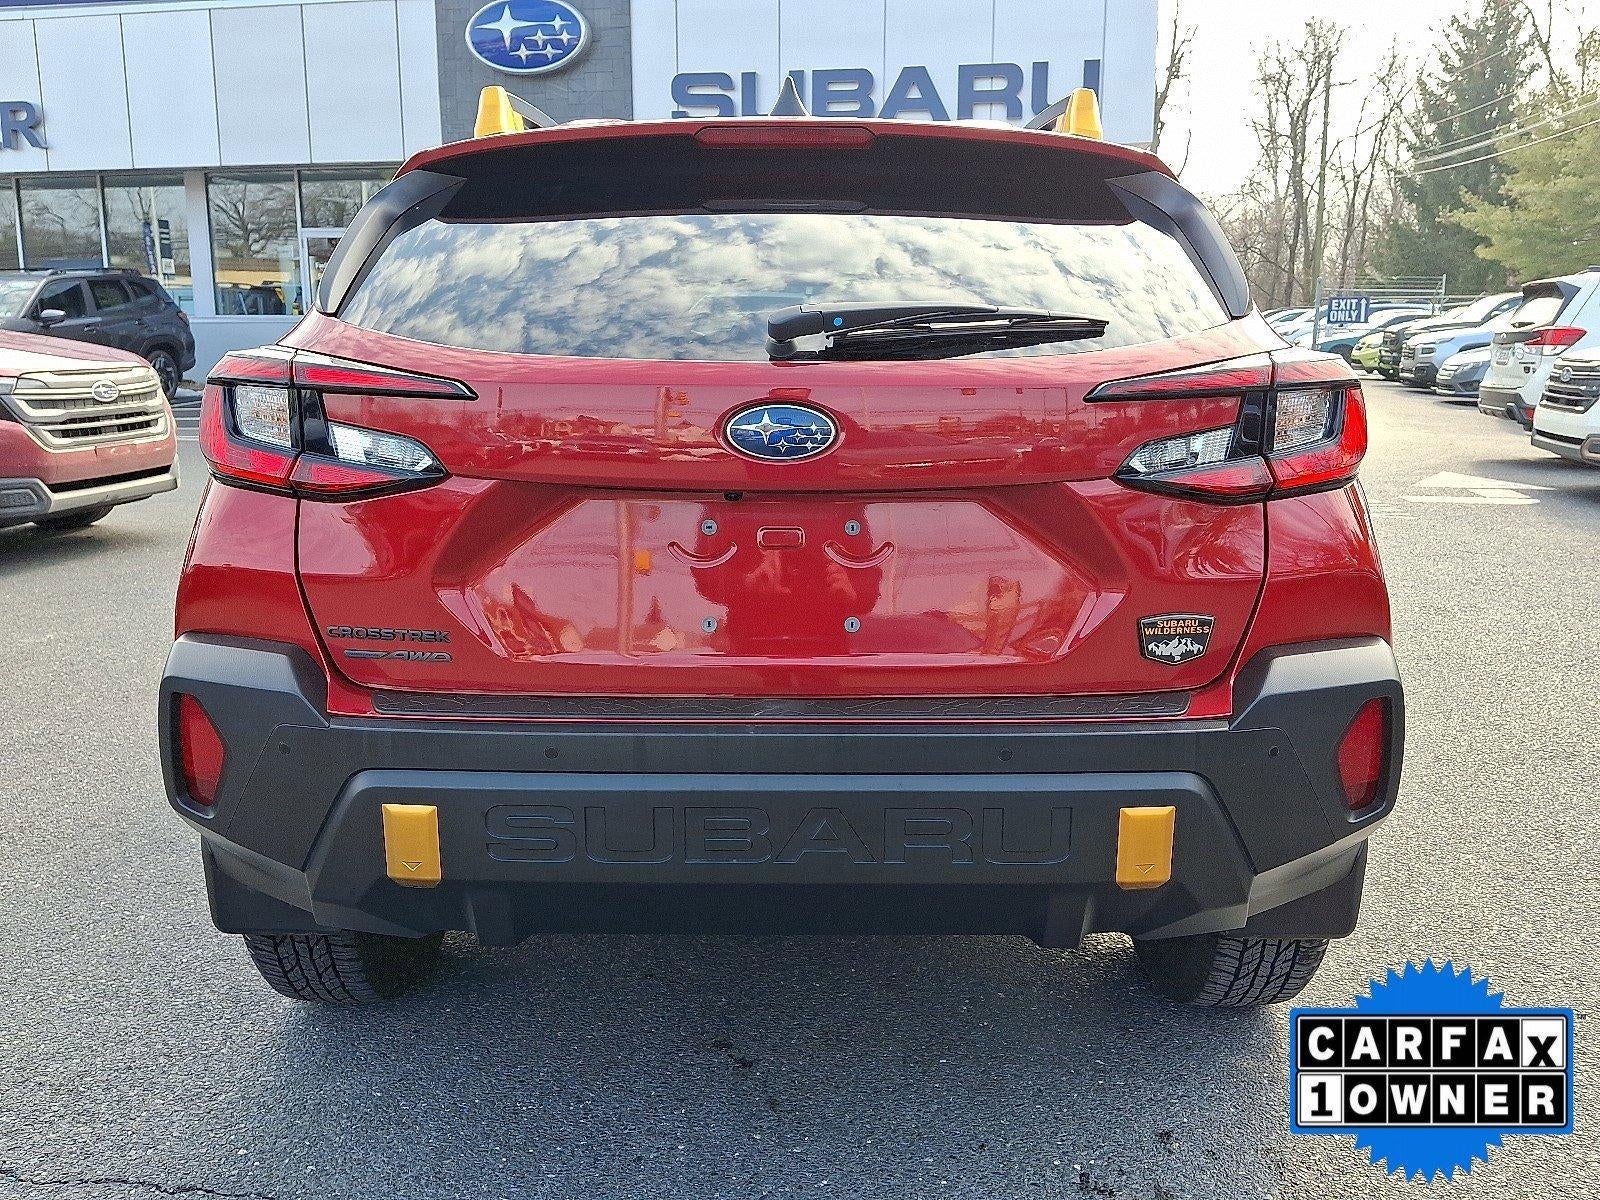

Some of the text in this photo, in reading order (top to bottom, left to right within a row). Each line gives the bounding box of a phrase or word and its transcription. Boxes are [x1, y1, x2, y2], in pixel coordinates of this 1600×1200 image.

[671, 59, 1101, 120] SUBARU
[0, 101, 48, 150] R
[1332, 299, 1358, 310] EXIT
[1330, 310, 1358, 322] ONLY
[1156, 619, 1199, 627] SUBARU
[327, 626, 452, 643] CROSSTREK
[1144, 626, 1210, 636] WILDERNESS
[383, 650, 453, 663] AWD
[484, 804, 1073, 864] SUBARU
